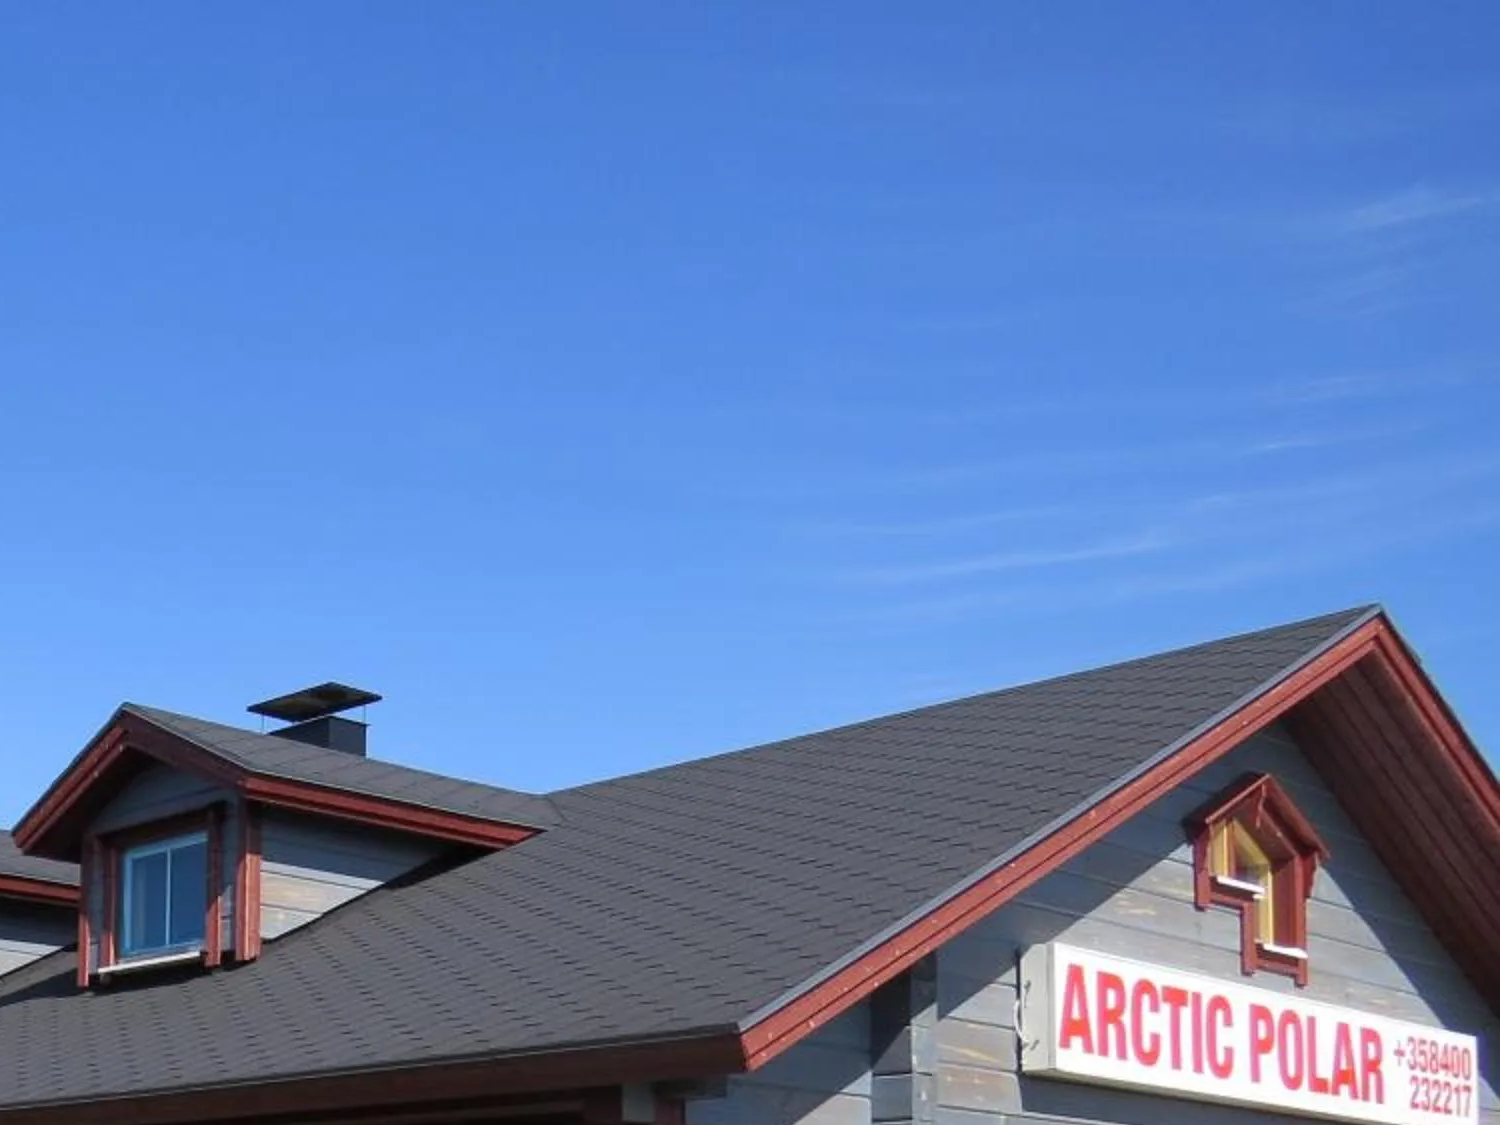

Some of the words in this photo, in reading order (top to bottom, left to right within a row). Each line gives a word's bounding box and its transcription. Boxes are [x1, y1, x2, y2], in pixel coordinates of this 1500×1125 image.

[1059, 963, 1233, 1079] ARCTIC
[1249, 1004, 1384, 1104] POLAR
[1393, 1036, 1472, 1081] +358400
[1410, 1075, 1472, 1117] 232217
